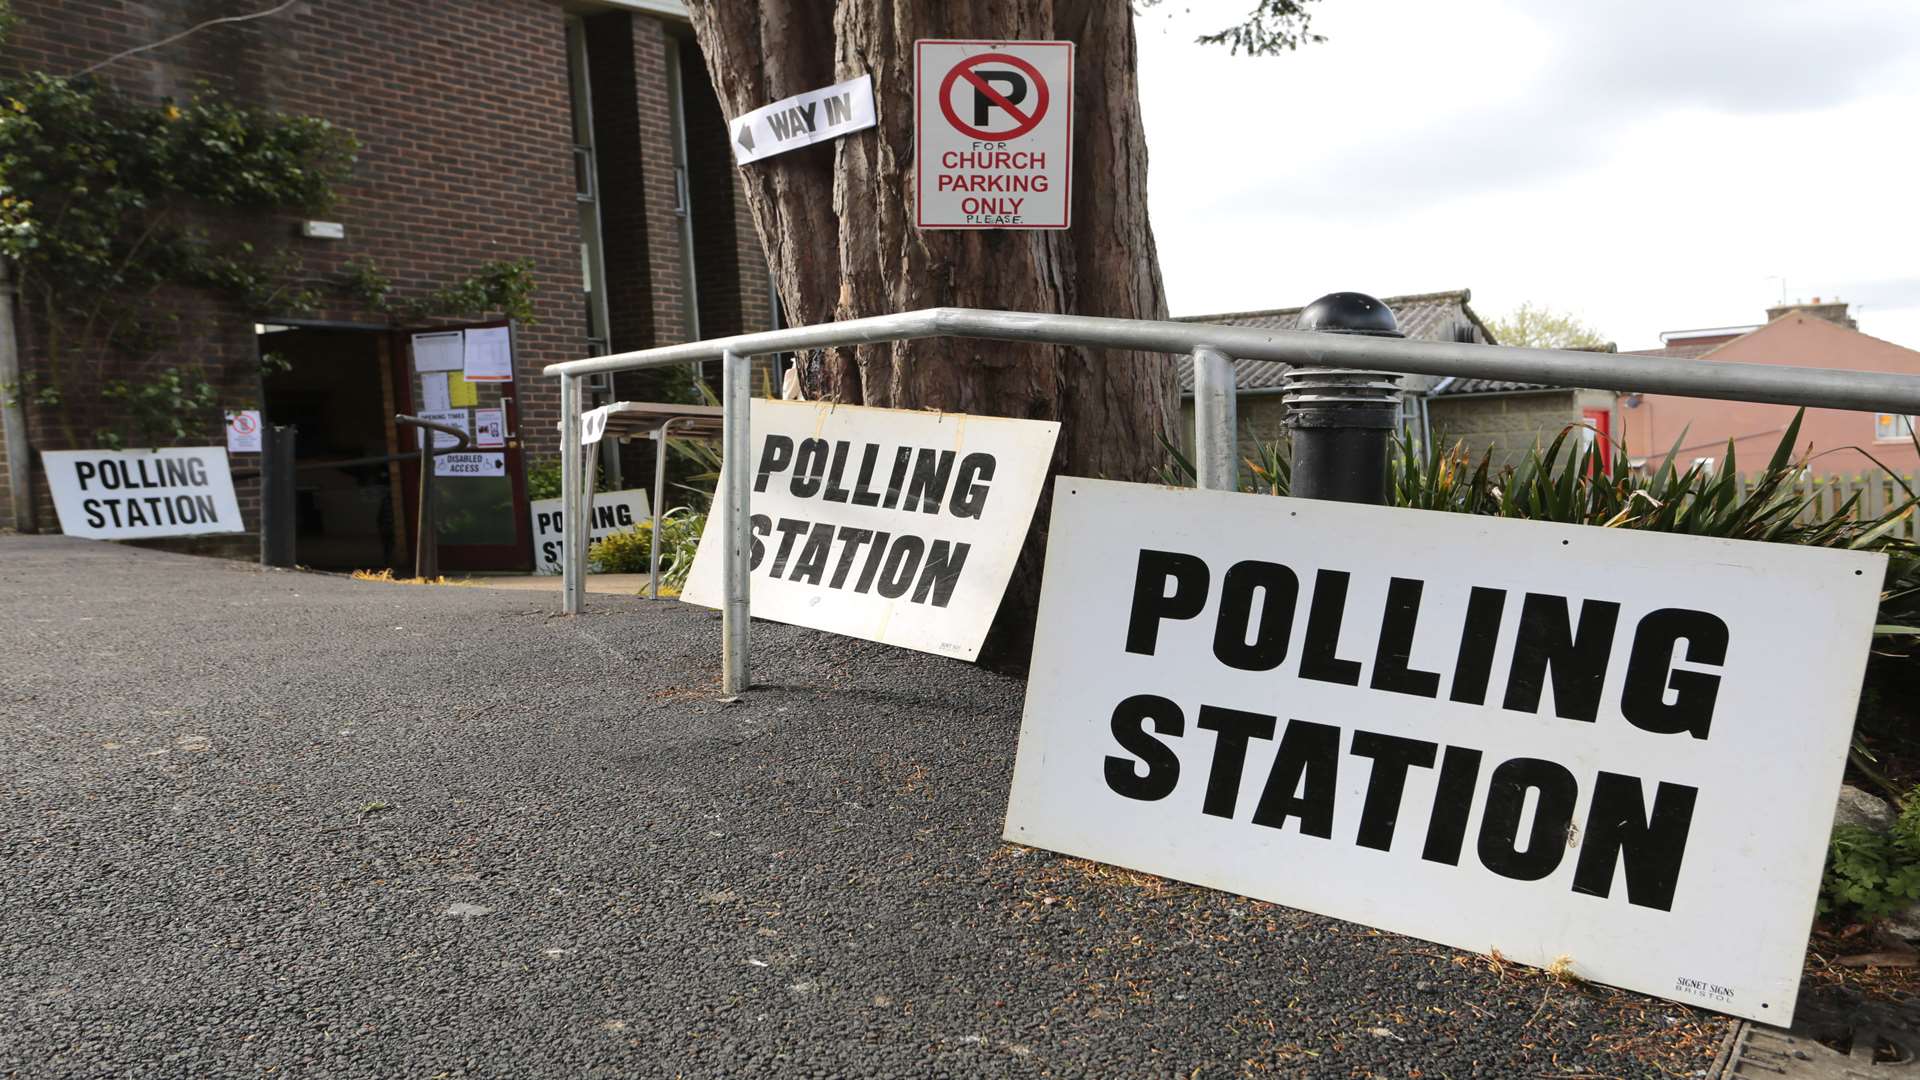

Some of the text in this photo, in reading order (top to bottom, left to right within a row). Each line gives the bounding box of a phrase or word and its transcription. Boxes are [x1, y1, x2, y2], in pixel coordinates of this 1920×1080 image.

[974, 71, 1027, 126] P
[766, 93, 850, 142] WAY IN
[972, 142, 1007, 151] FOR
[942, 152, 1046, 169] CHURCH
[938, 175, 1048, 192] PARKING
[961, 198, 1024, 215] ONLY
[447, 455, 483, 463] DISABLED
[449, 464, 480, 472] ACCESS
[74, 457, 209, 491] POLLING
[753, 434, 997, 520] POLLING
[83, 495, 218, 529] STATION
[537, 504, 634, 535] POING
[1124, 549, 1729, 740] POLLING
[1103, 695, 1699, 912] STATION
[1675, 986, 1731, 1003] BRISTOL
[1677, 977, 1735, 997] SIGNET SIGNS
